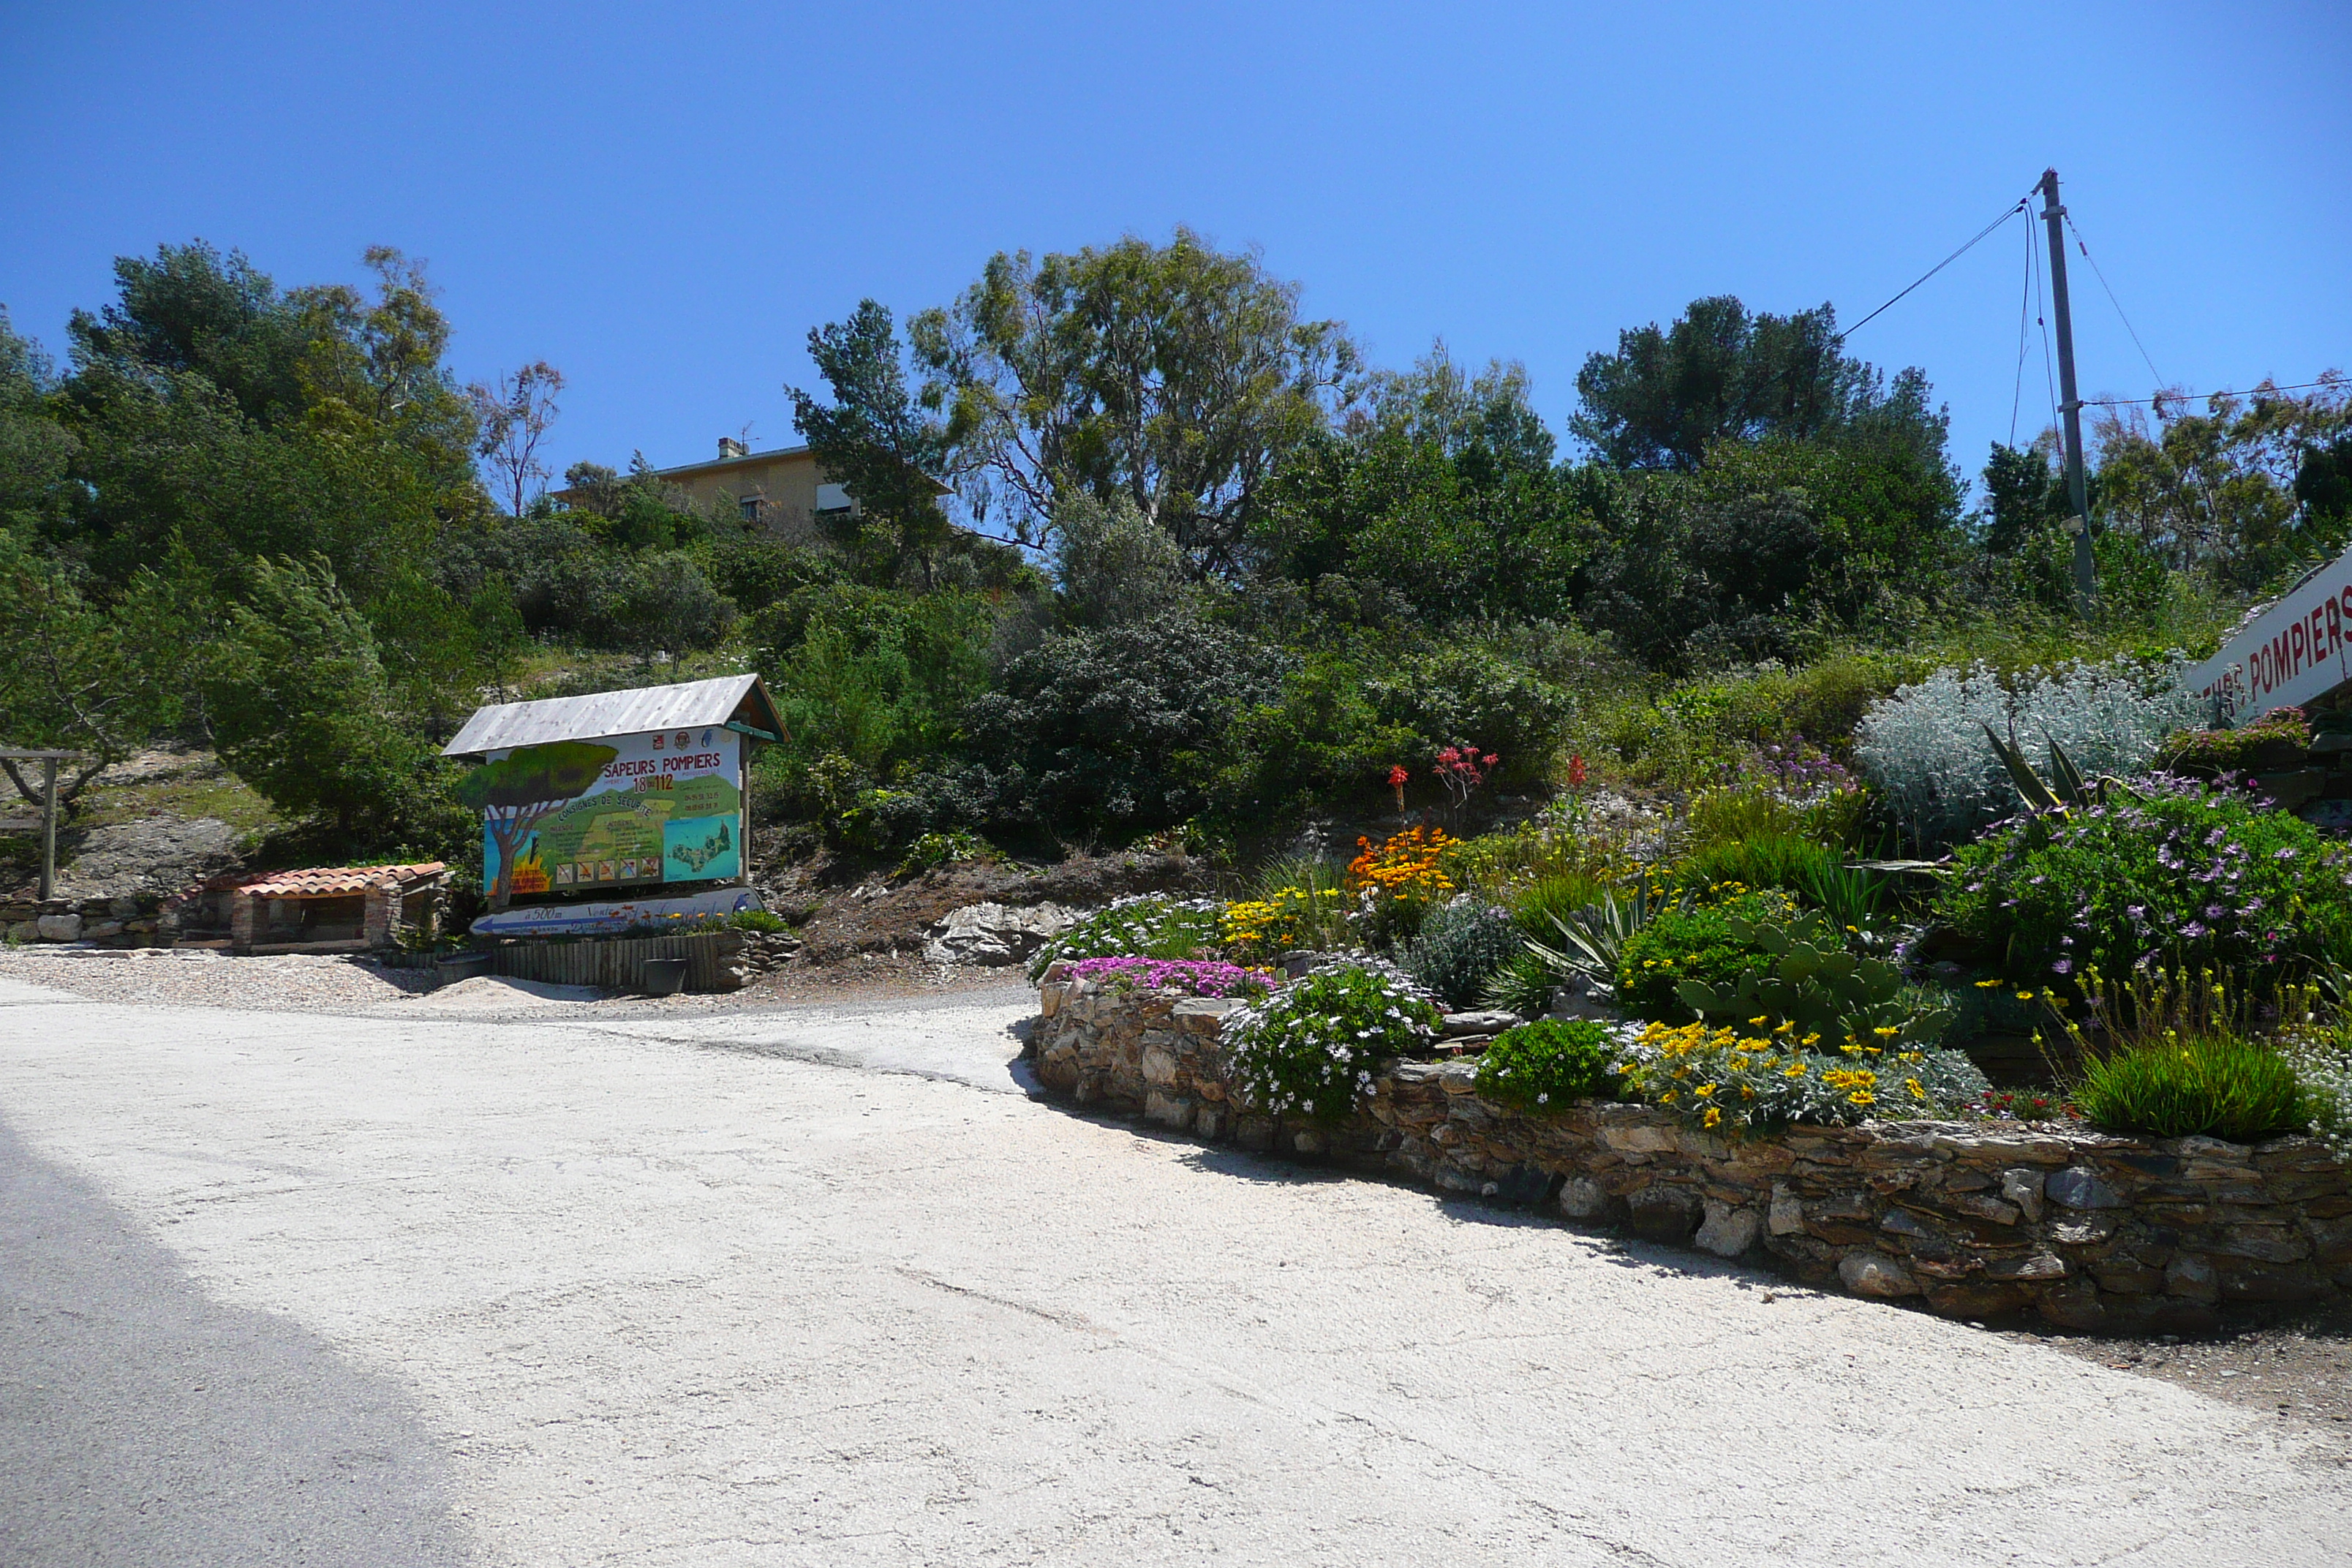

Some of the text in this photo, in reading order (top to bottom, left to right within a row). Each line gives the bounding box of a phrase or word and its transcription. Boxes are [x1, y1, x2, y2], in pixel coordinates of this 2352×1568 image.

[2250, 585, 2352, 702] POMPIERS
[603, 753, 720, 778] SAPEURS POMPIERS
[633, 777, 647, 793] 18
[655, 774, 673, 791] 112
[558, 797, 598, 821] CONSIGNES
[601, 796, 612, 805] DE
